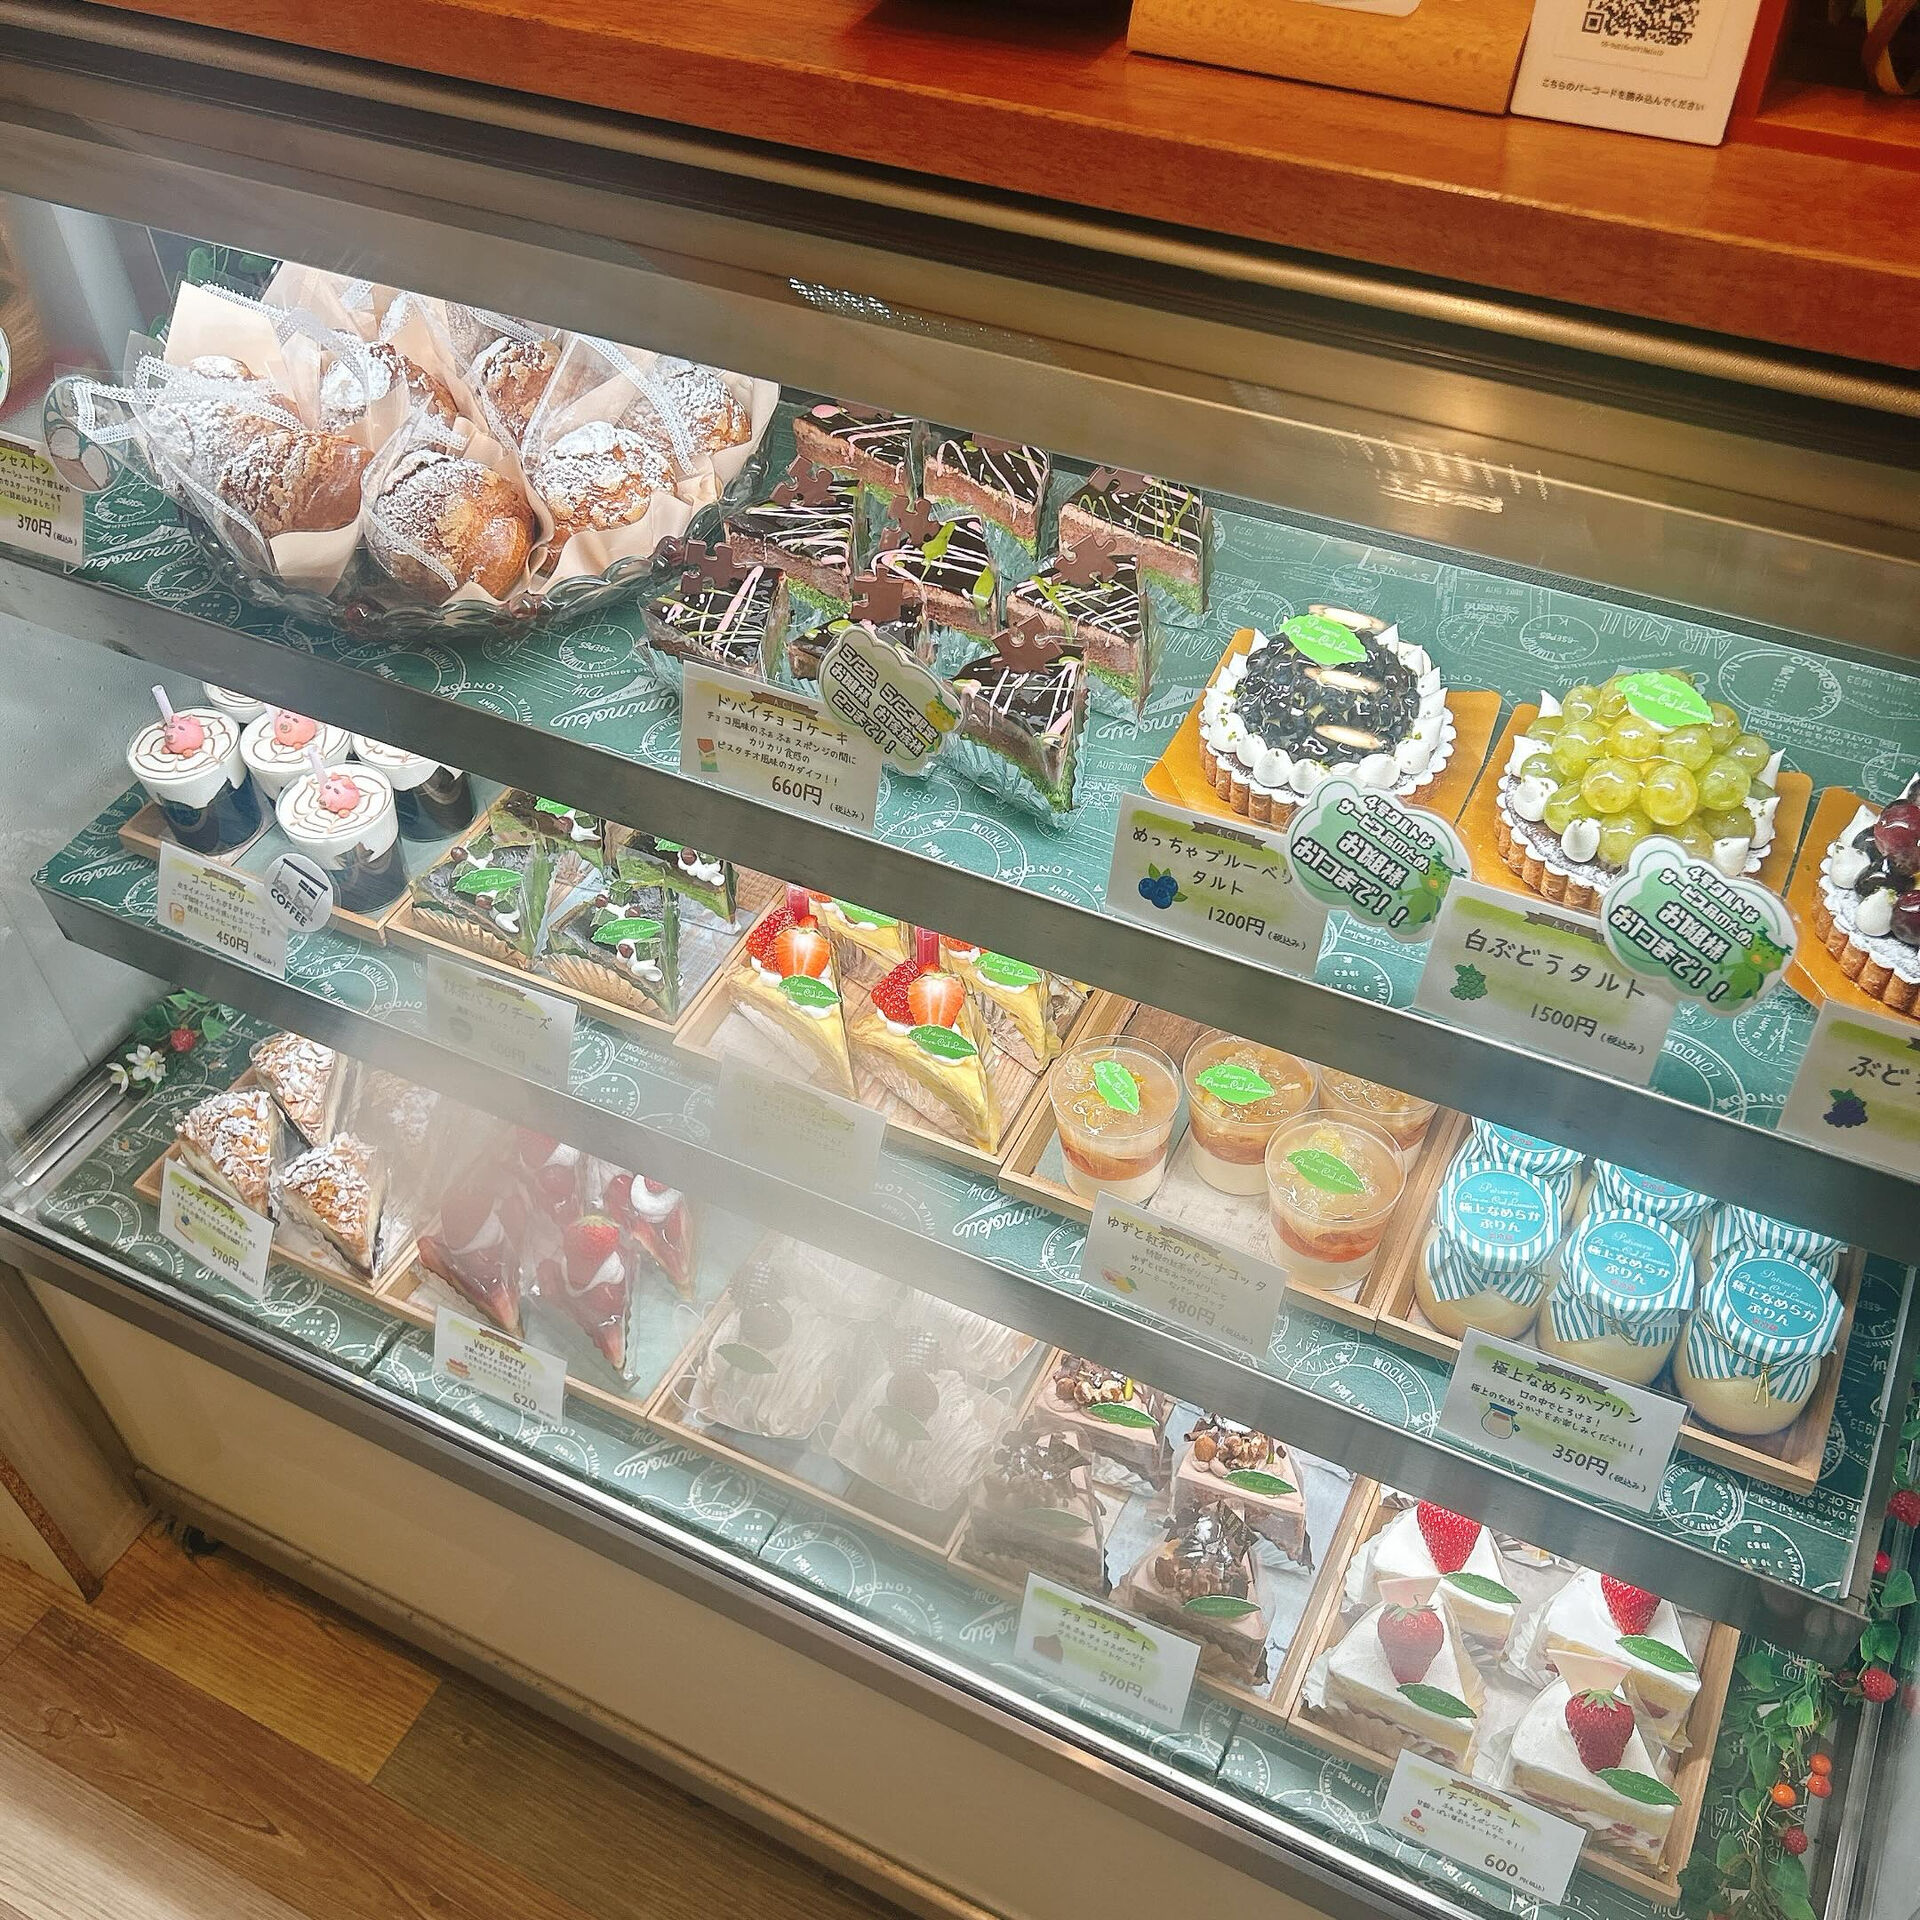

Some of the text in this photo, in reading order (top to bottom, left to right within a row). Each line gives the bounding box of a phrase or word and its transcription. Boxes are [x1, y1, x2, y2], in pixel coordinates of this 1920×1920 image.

[17, 514, 52, 538] 370円
[1599, 608, 1671, 646] MAIL
[717, 694, 849, 743] ドバイチョコケーキ
[749, 737, 810, 764] カリカリ食感の
[772, 775, 823, 806] 660円
[902, 788, 938, 805] 1968
[191, 873, 255, 904] コーヒーゼリー
[1192, 870, 1244, 896] タルト
[270, 888, 307, 927] COFFEE
[1207, 907, 1266, 936] 1200円
[216, 930, 249, 954] 450円
[1464, 928, 1646, 1000] 白ぶどうタルト
[1531, 1003, 1598, 1039] 1500円
[1849, 1055, 1920, 1096] ぶど
[1459, 1202, 1540, 1222] 極上なめらか
[1479, 1218, 1521, 1233] ぷりん
[212, 1246, 239, 1271] 570円
[1107, 1215, 1267, 1291] ゆずと紅茶のパンナコッタ
[1588, 1244, 1671, 1279] 極上なめらか
[1605, 1263, 1647, 1285] ぷりん
[1168, 1297, 1217, 1327] 480円
[1732, 1279, 1817, 1322] 極上なめらか
[1747, 1302, 1789, 1326] ぷりん
[473, 1339, 496, 1356] Very
[500, 1350, 526, 1369] Berry
[513, 1392, 537, 1411] 620
[1491, 1359, 1642, 1424] 極上なめらかプリン
[1551, 1444, 1610, 1477] 350円
[1061, 1607, 1150, 1650] チョコショート
[1099, 1671, 1143, 1698] 570円
[1433, 1787, 1521, 1828] イチゴショート
[1484, 1854, 1519, 1878] 600
